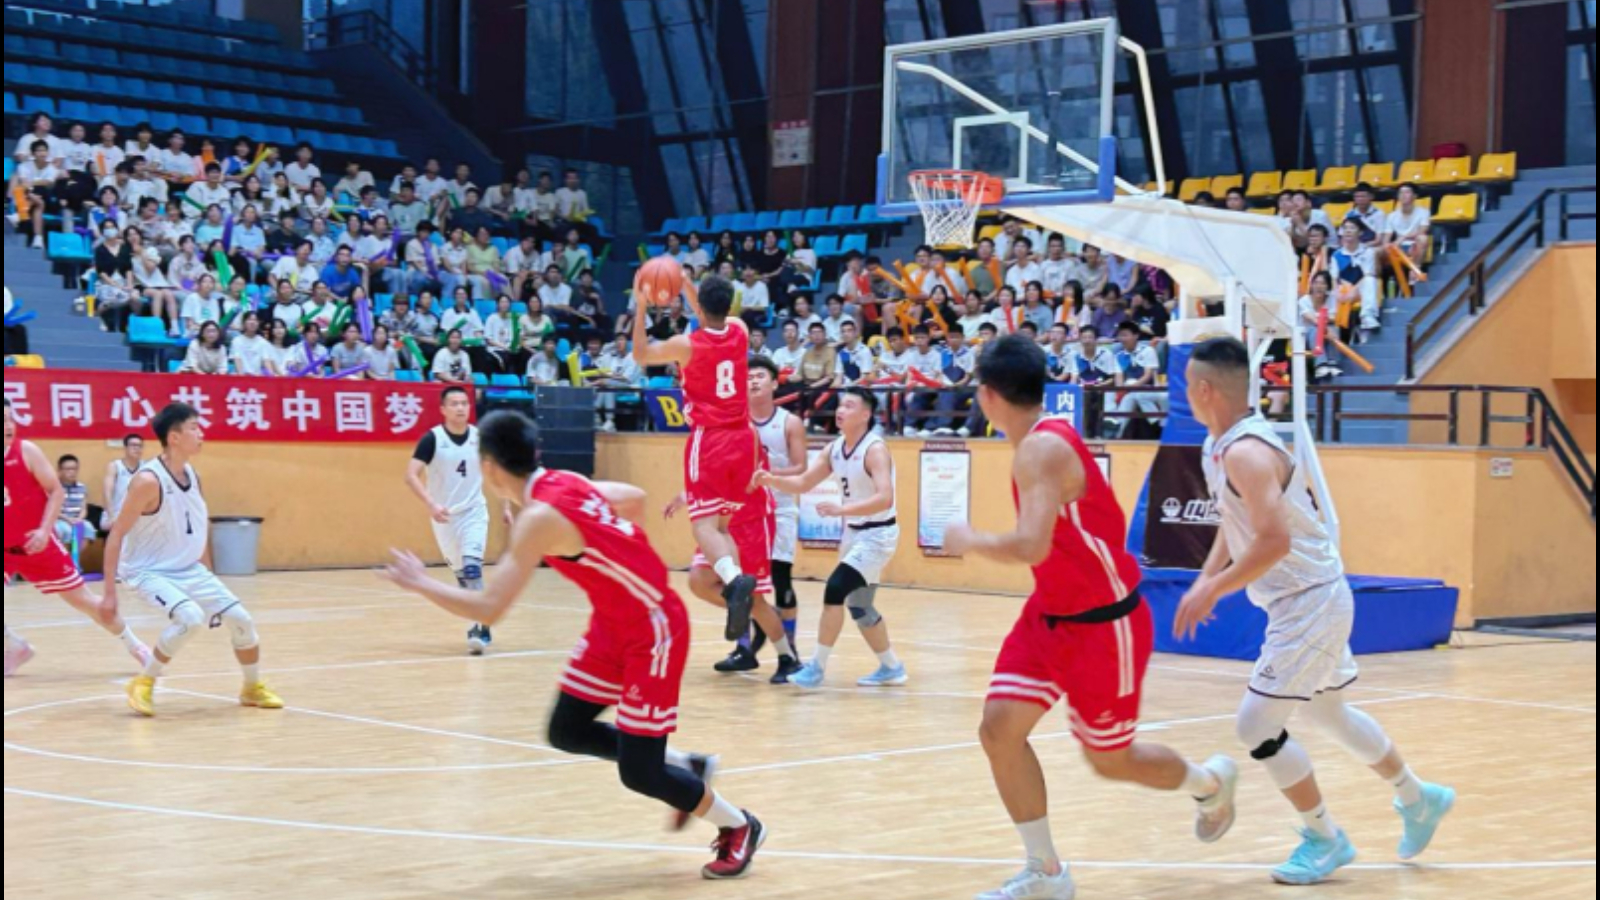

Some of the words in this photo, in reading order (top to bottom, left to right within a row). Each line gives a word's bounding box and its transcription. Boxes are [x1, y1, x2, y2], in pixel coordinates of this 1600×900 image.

[715, 360, 737, 399] 8
[456, 459, 467, 477] 4
[184, 511, 193, 534] 1
